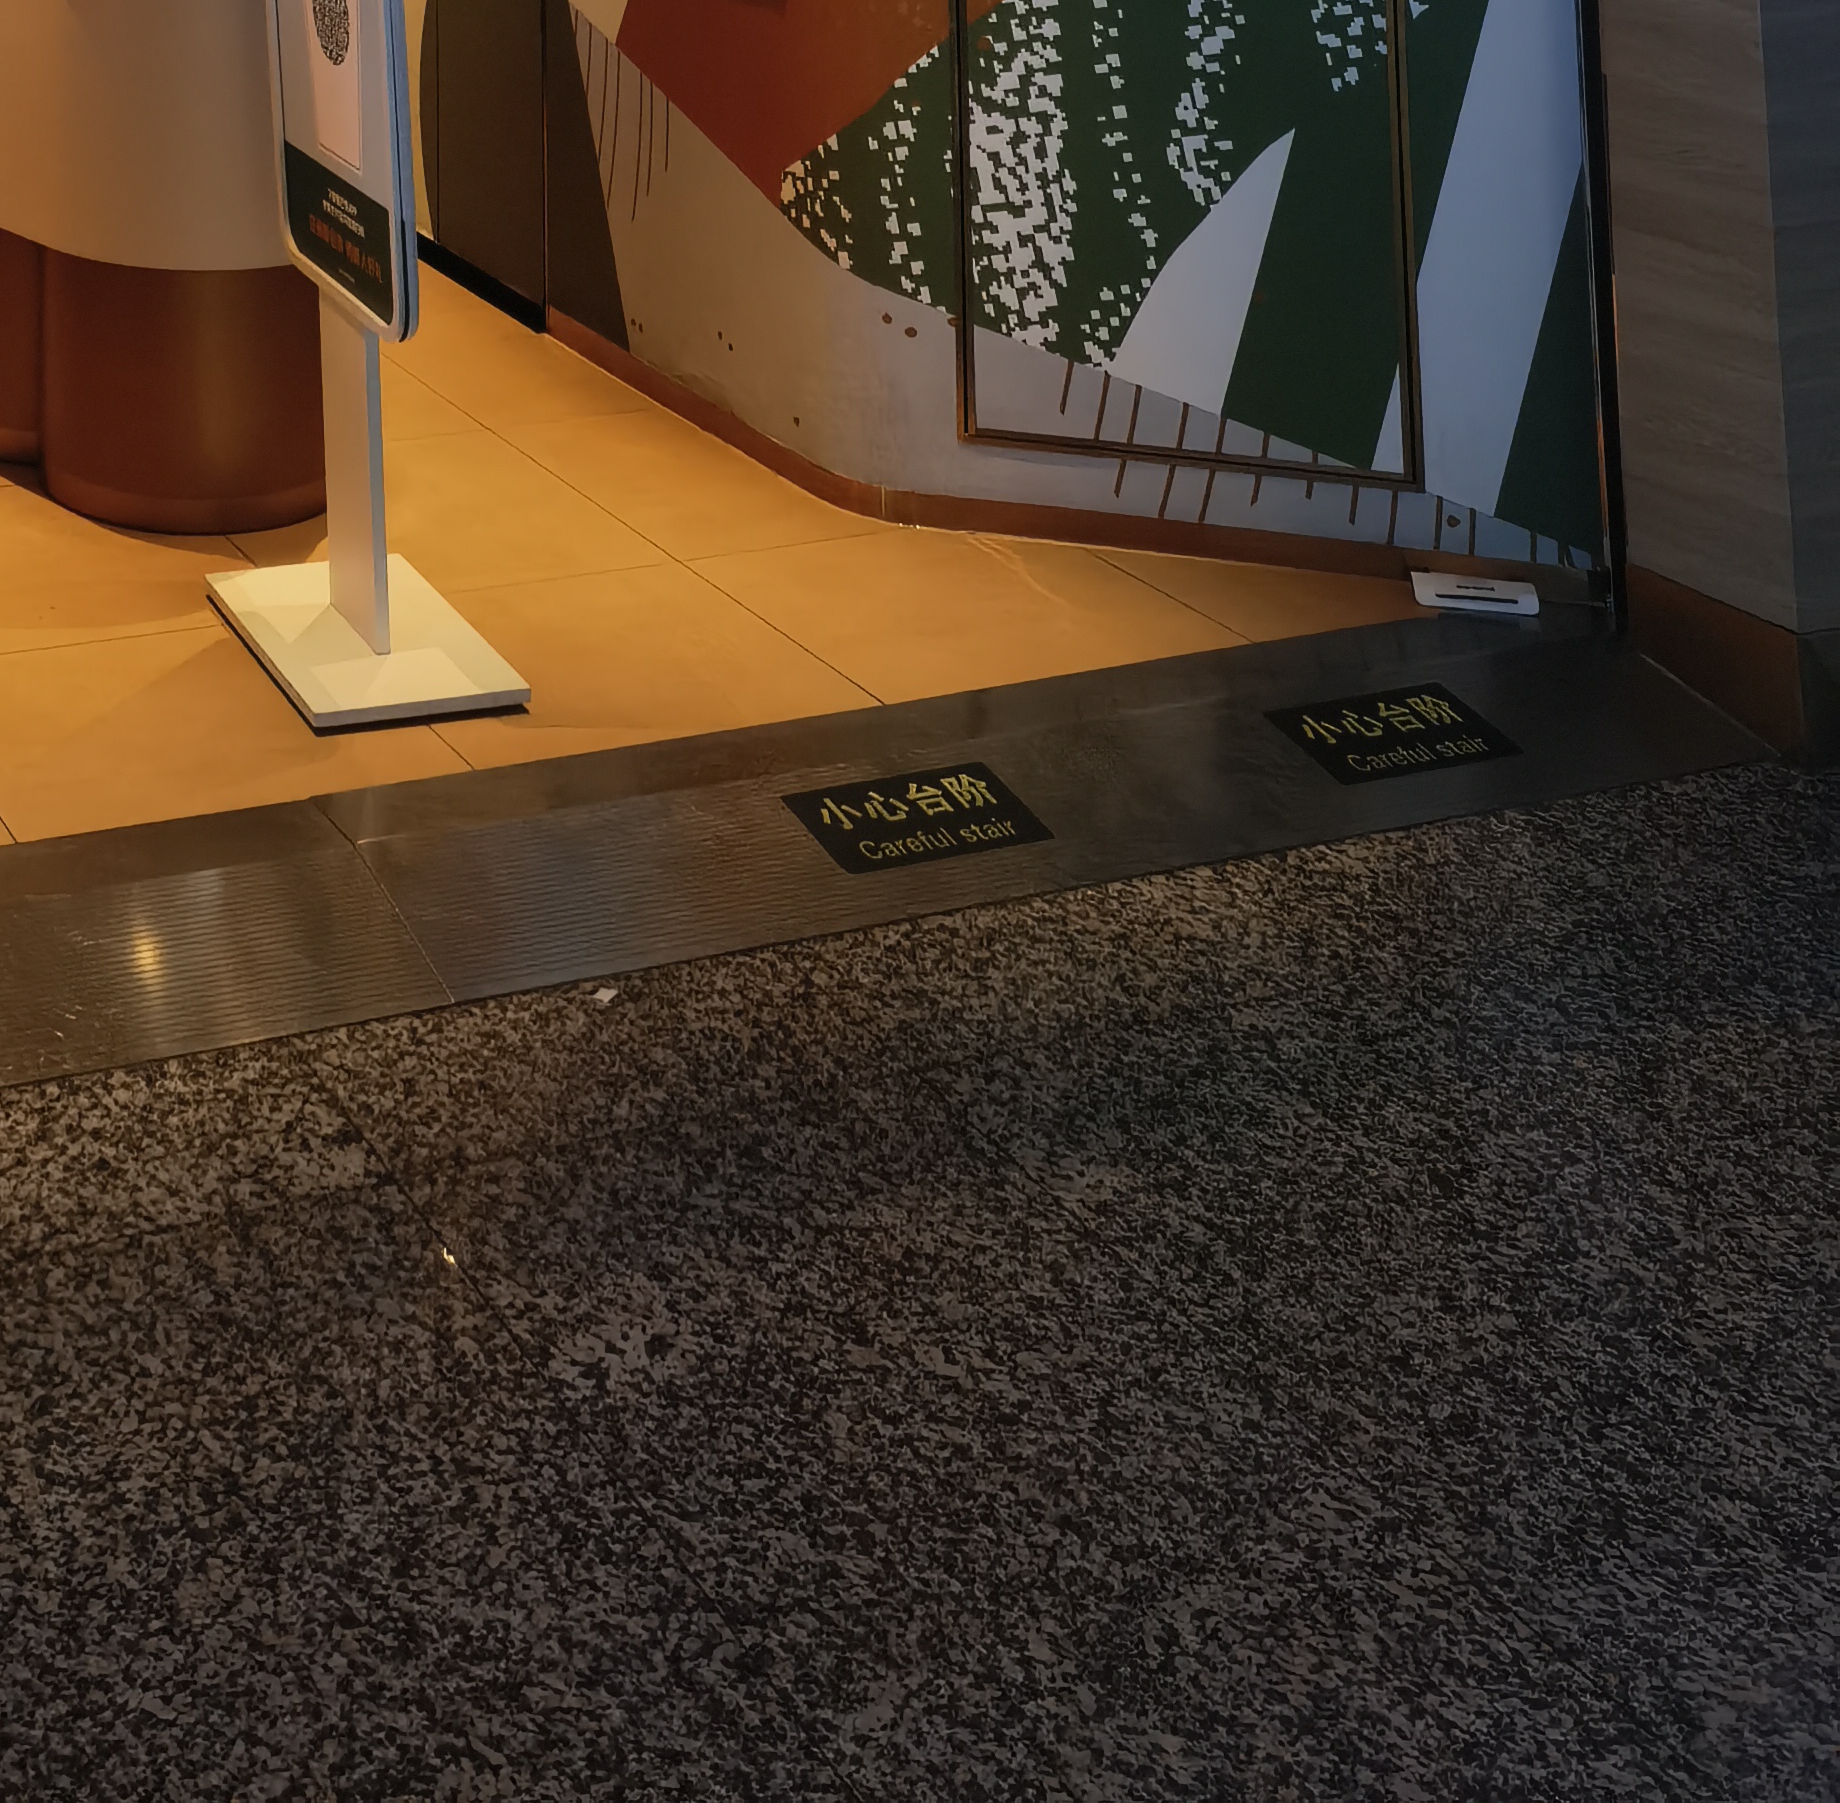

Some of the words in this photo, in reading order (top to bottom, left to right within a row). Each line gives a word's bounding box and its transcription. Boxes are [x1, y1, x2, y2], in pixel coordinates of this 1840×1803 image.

[1301, 694, 1464, 745] 小心台阶
[1347, 742, 1437, 772] Careful
[1436, 734, 1490, 759] stair
[820, 773, 998, 831] 小心台阶
[858, 826, 958, 860] Careful
[960, 817, 1018, 844] stair
